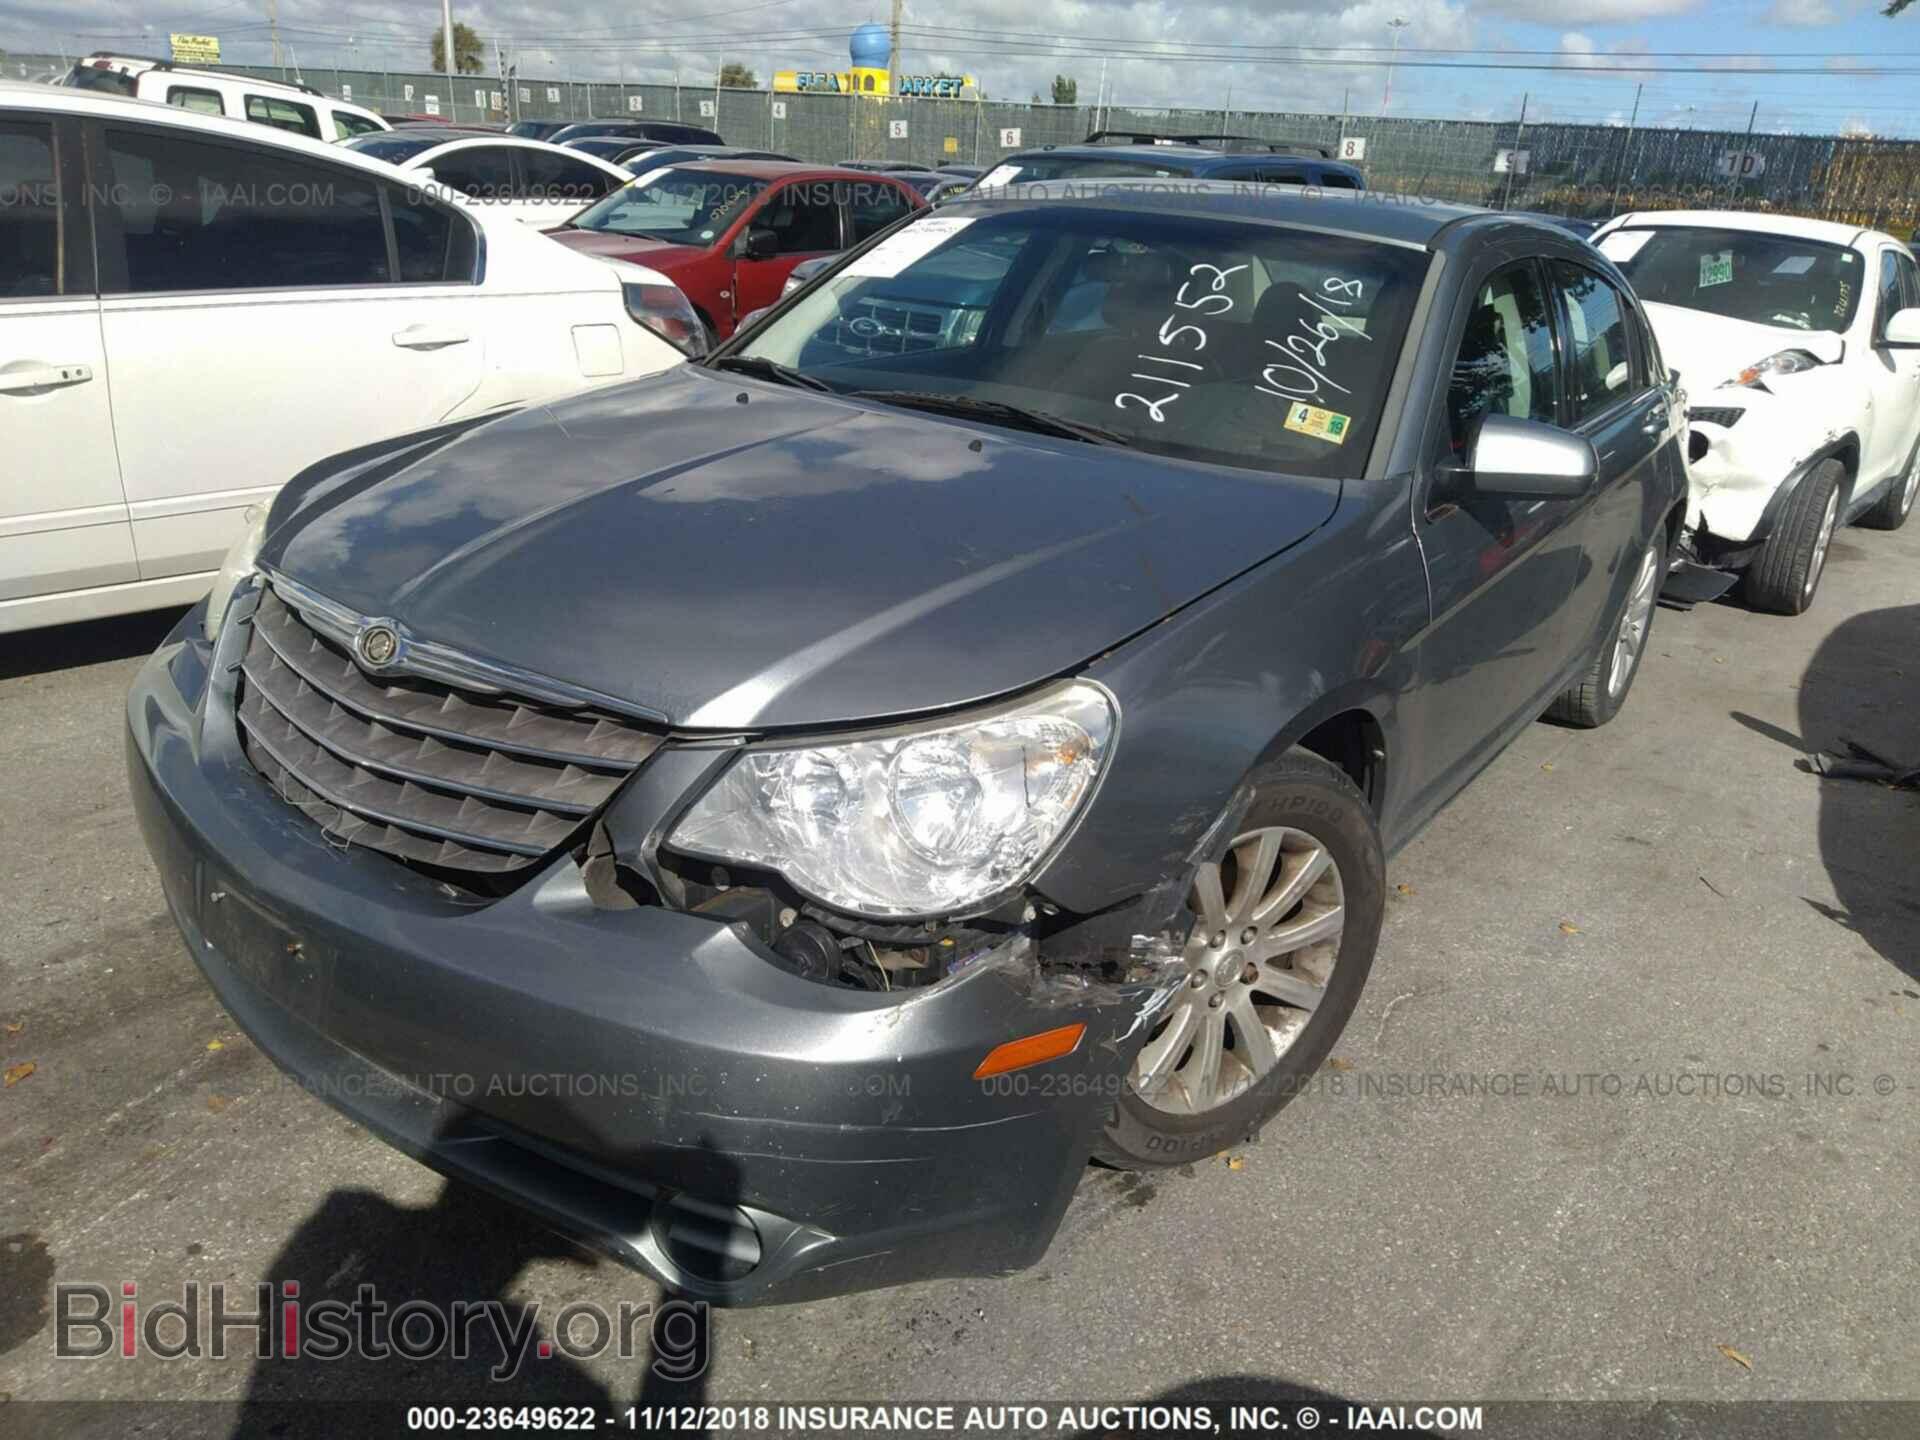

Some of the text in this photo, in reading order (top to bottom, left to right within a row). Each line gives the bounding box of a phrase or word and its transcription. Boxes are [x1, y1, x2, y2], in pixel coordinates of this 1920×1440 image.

[897, 75, 964, 97] ARKET
[894, 122, 902, 136] 5
[1006, 131, 1014, 144] 6
[1345, 140, 1355, 157] 8
[1115, 263, 1249, 422] 211552
[1254, 276, 1373, 403] 10/26/18
[1298, 408, 1309, 423] 4
